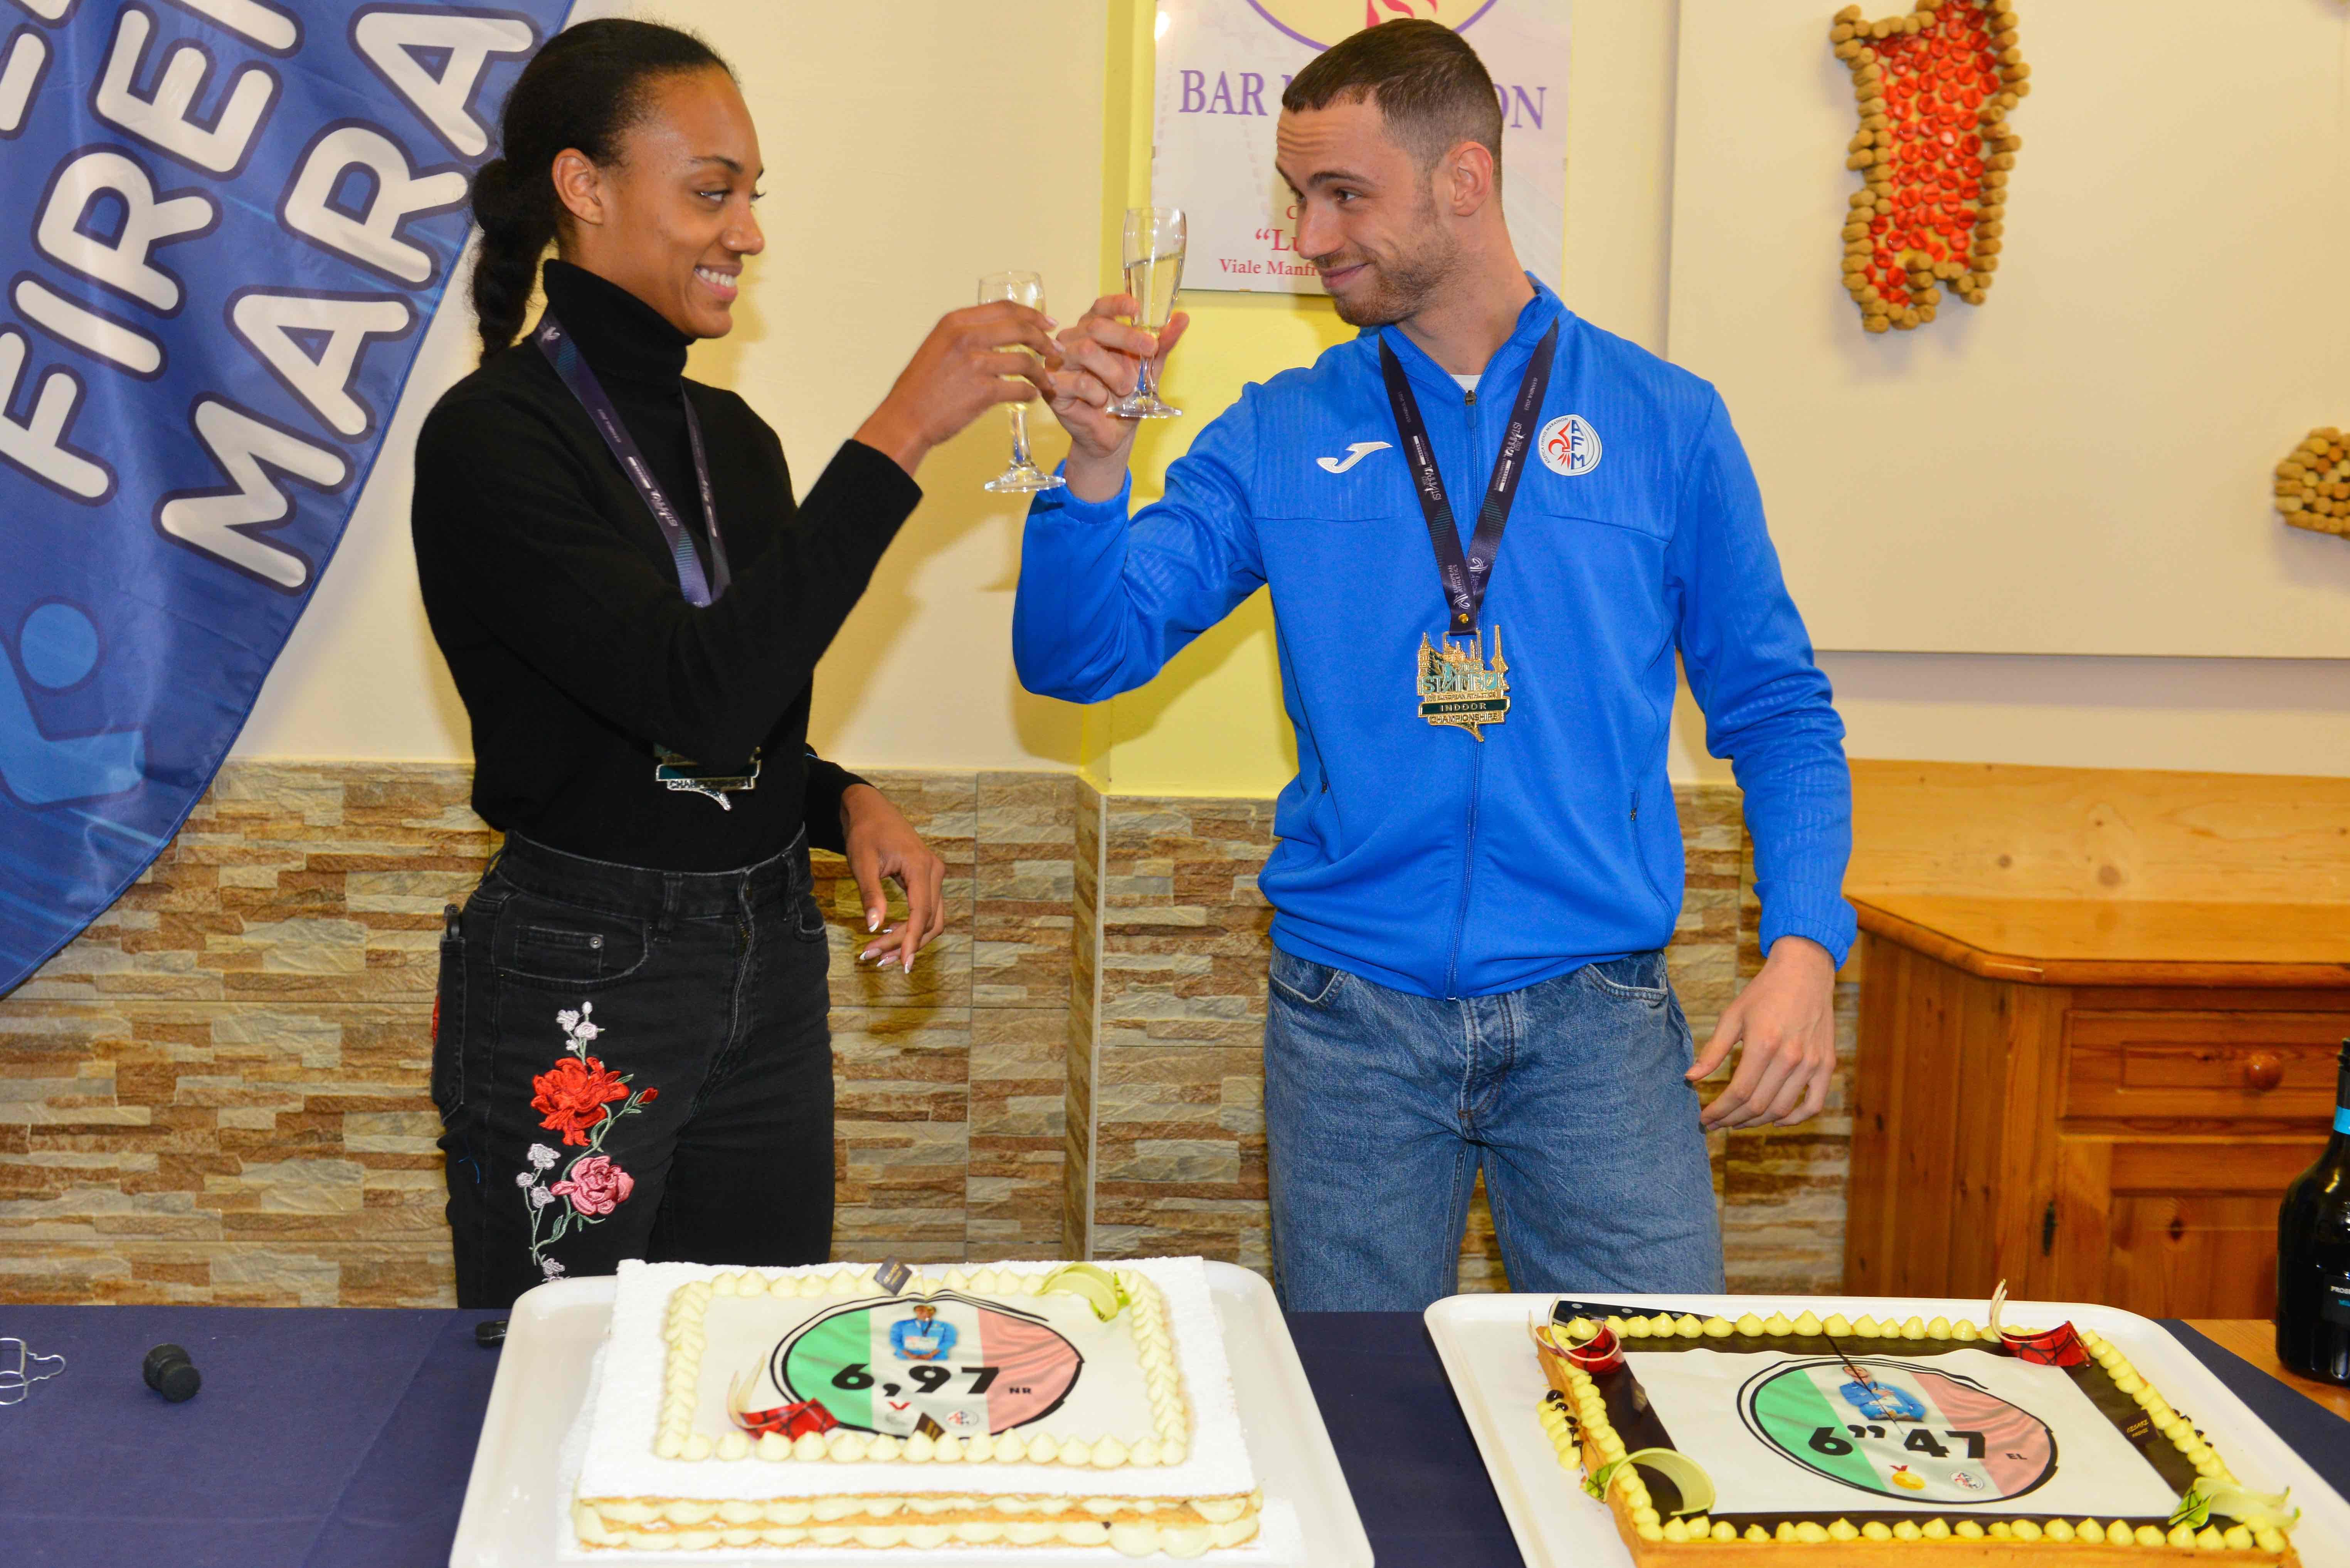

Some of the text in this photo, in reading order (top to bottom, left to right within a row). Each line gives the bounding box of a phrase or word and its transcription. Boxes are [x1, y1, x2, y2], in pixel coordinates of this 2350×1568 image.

[1179, 70, 1268, 116] BAR
[1219, 259, 1320, 276] Viale Manfr
[1546, 417, 1568, 432] MARATHON
[1448, 565, 1459, 593] EUROPEAN
[1452, 564, 1463, 592] ATHLETICS
[1429, 713, 1499, 723] CHAMPIONSHIPS
[1440, 703, 1487, 712] INDOOR
[831, 1363, 1000, 1397] 6,97
